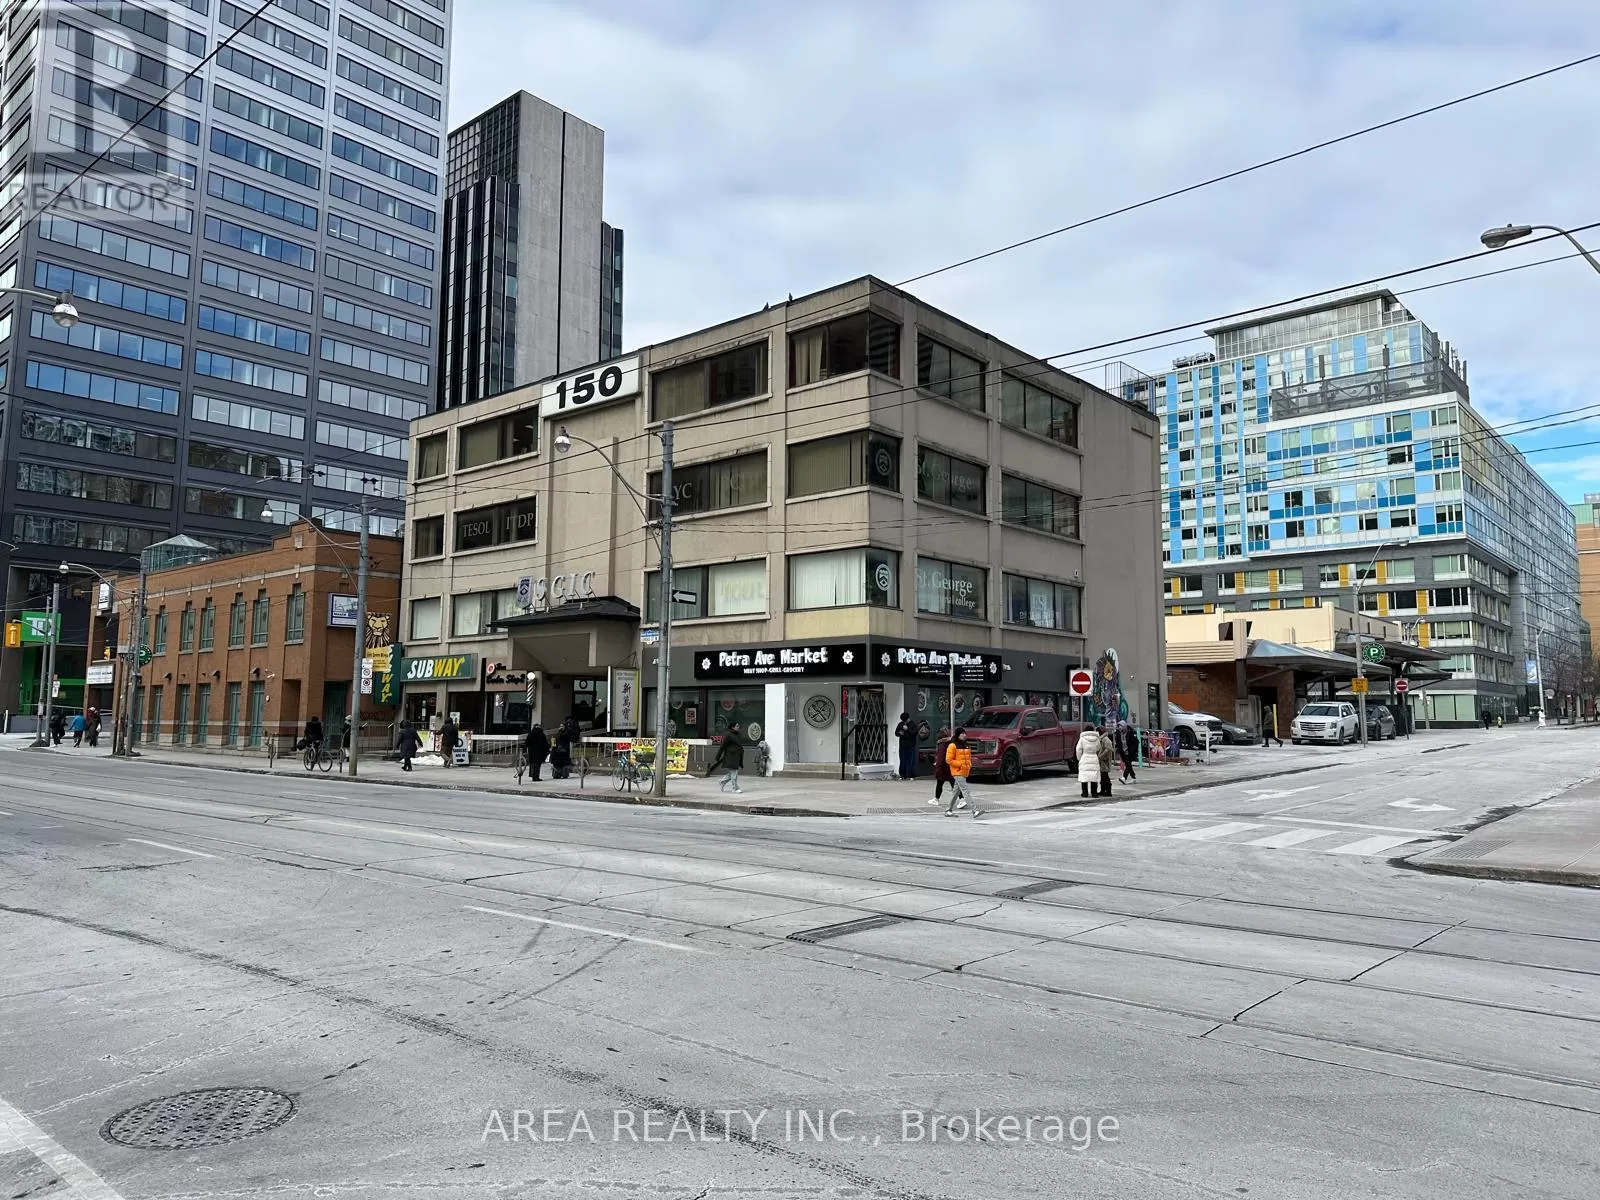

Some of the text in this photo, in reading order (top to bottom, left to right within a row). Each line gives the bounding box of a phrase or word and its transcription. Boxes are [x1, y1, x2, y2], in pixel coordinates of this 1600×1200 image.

[556, 365, 623, 410] 150
[462, 521, 491, 538] TESOL
[535, 570, 596, 601] SGIC
[932, 571, 973, 597] George
[955, 596, 976, 609] college
[719, 646, 828, 667] Petra Ave Market
[897, 648, 927, 665] Petra
[929, 651, 948, 665] Ave
[1370, 647, 1379, 657] P
[407, 656, 466, 679] SUBWAY
